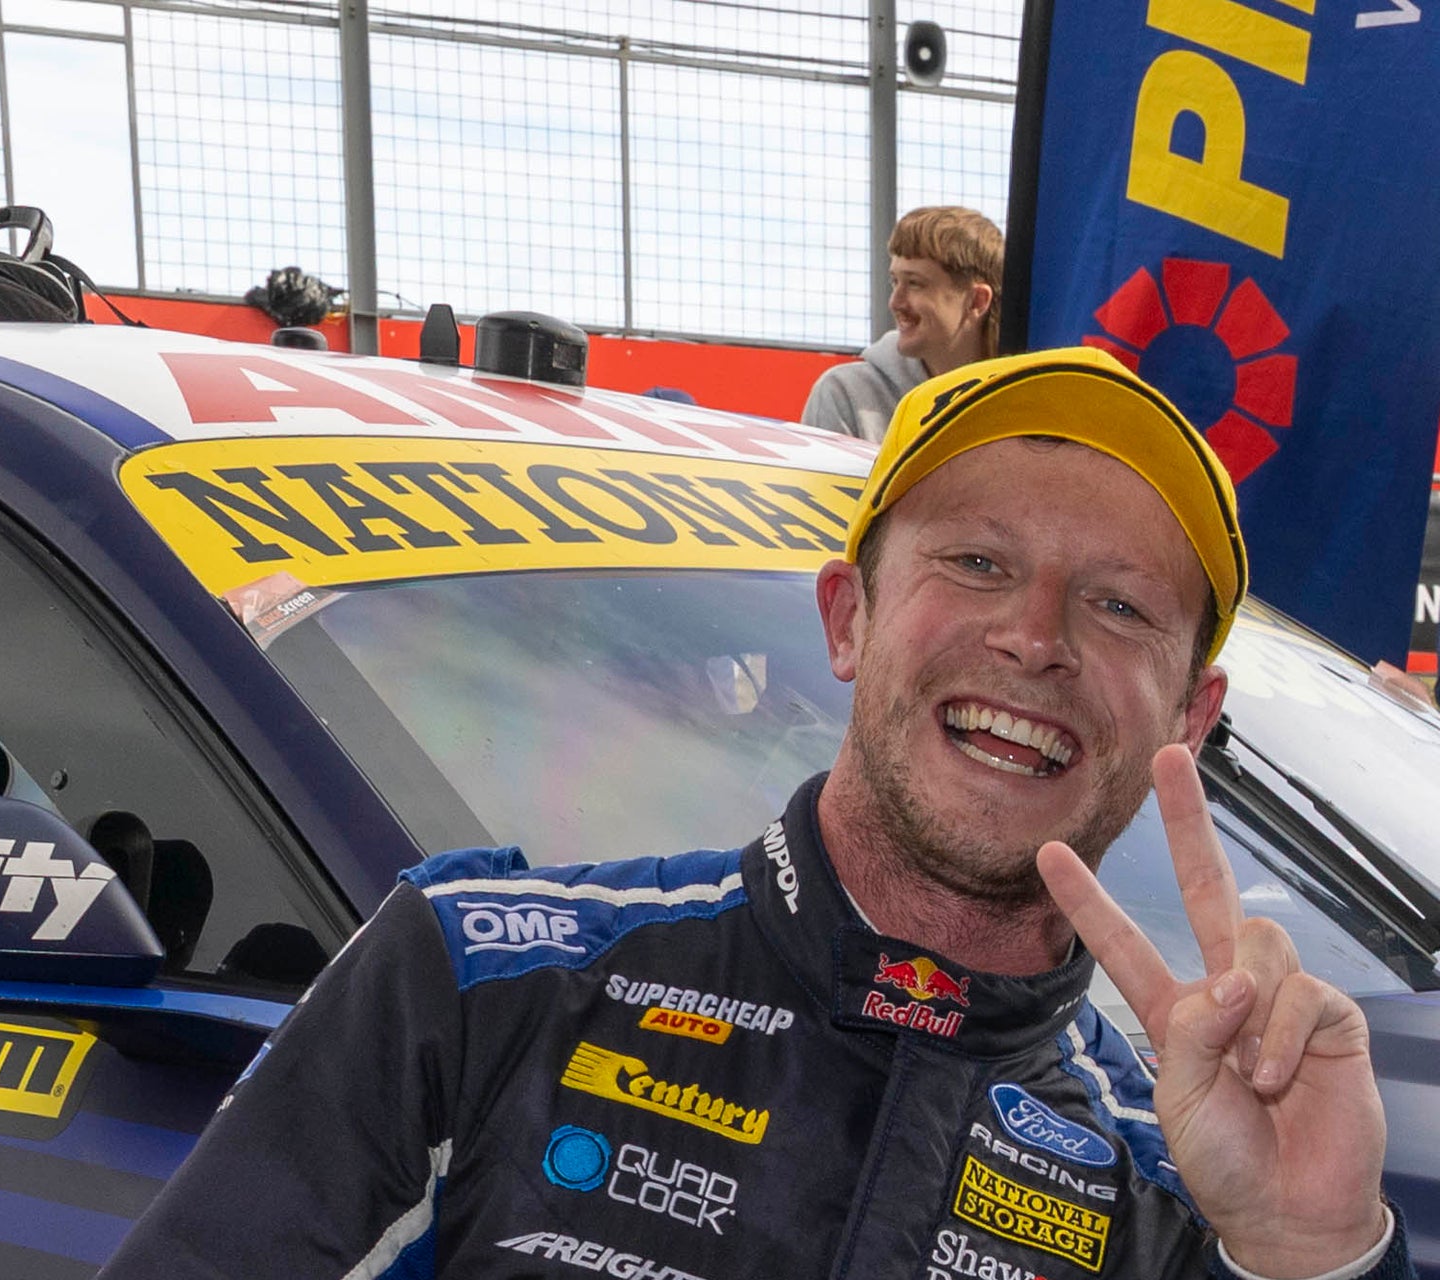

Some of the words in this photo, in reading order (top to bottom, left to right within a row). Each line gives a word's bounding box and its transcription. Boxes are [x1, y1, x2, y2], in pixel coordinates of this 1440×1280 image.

[162, 350, 878, 462] AMP
[764, 820, 802, 915] MPOL
[463, 905, 580, 946] OMP
[605, 973, 794, 1037] SUPERCHEAP
[649, 1010, 724, 1038] AUTO
[615, 1059, 771, 1139] Century
[1007, 1097, 1090, 1160] Ford
[616, 1143, 739, 1206] QUAD
[968, 1122, 1119, 1203] RACING
[607, 1171, 736, 1236] LOCK
[962, 1194, 1099, 1260] STORAGE
[965, 1158, 1108, 1238] NATIONAL
